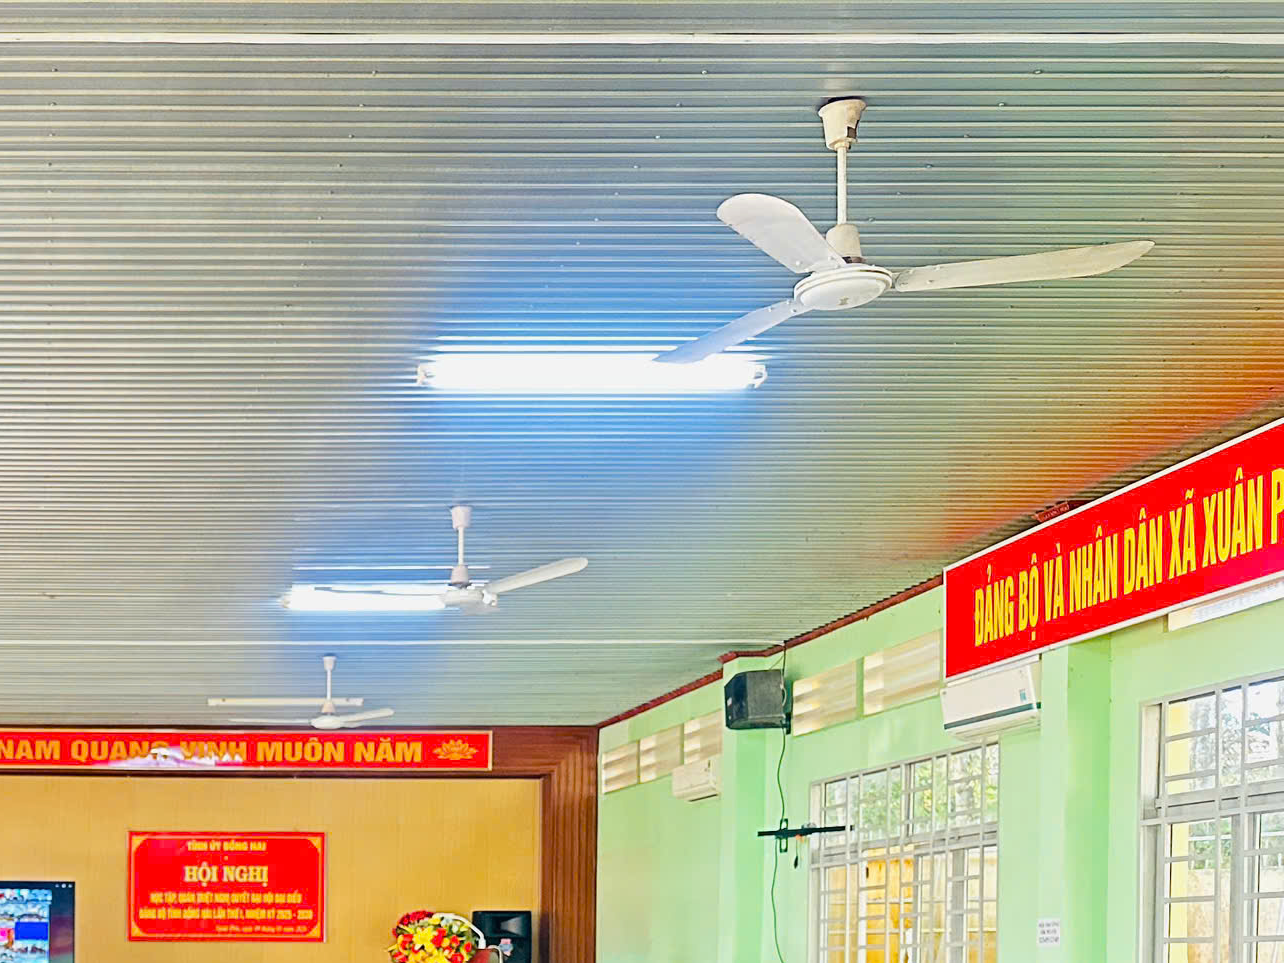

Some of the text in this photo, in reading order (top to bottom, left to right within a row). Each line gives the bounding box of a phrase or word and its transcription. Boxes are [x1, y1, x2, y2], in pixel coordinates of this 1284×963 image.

[974, 564, 1015, 647] ĐẢNG
[1018, 552, 1039, 641] BỘ
[1043, 543, 1065, 622] VÀ
[1069, 525, 1119, 614] NHÂN
[1123, 507, 1163, 595] DÂN
[1168, 488, 1197, 580] XÃ
[1202, 466, 1264, 568] XUÂN
[257, 736, 345, 763] MUÔN
[354, 737, 422, 763] NĂM
[184, 862, 268, 887] HỘI NGHỊ
